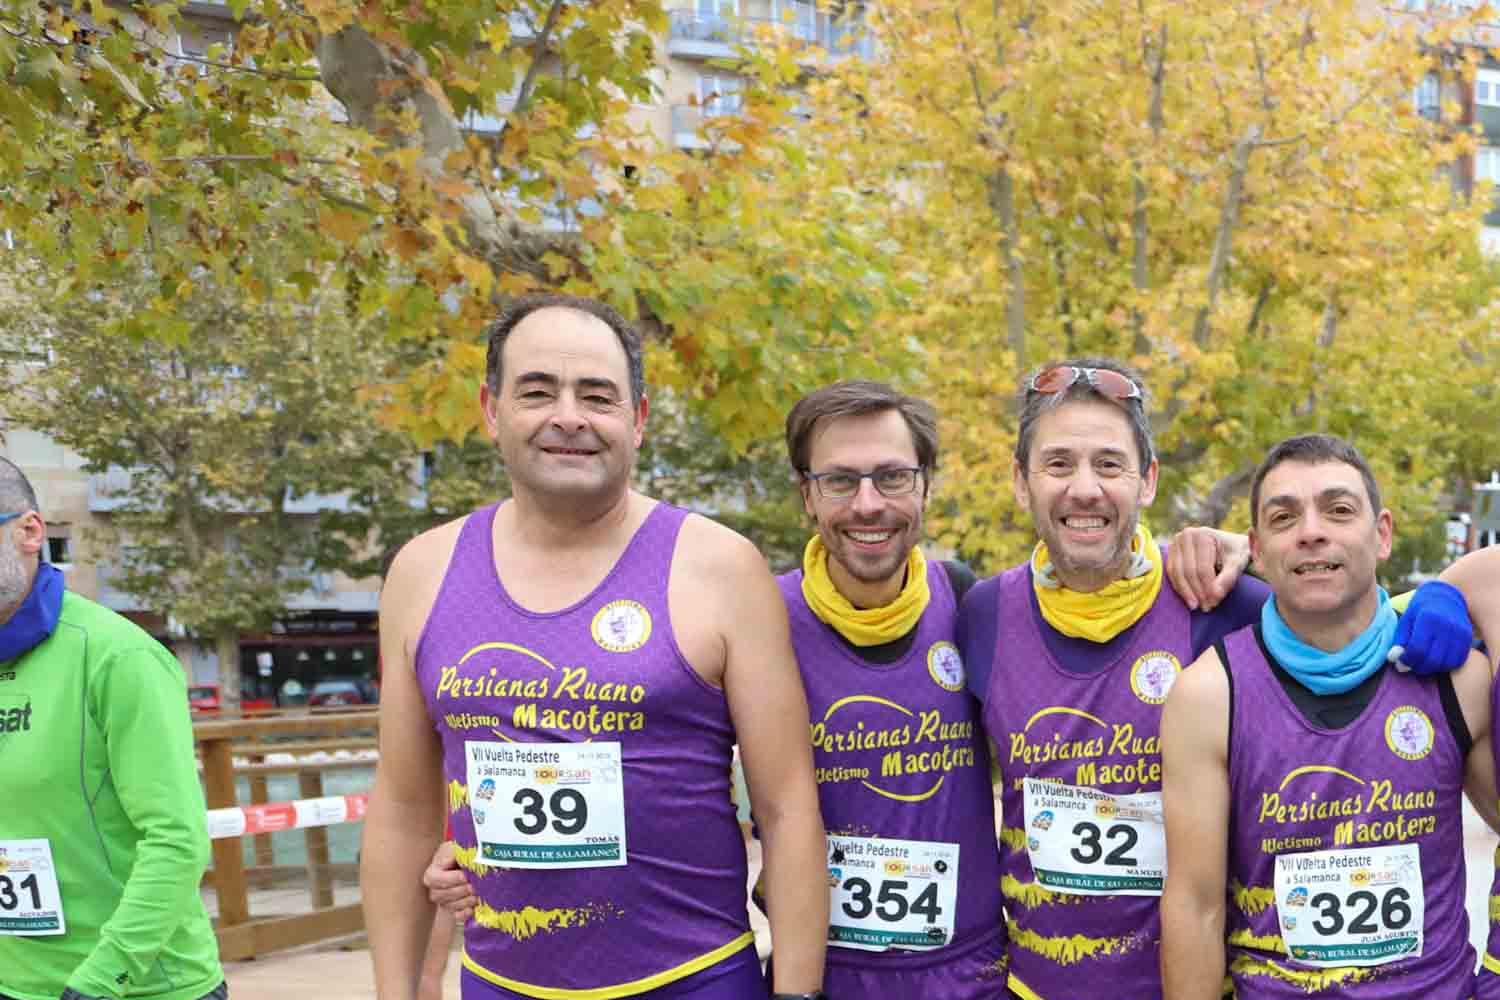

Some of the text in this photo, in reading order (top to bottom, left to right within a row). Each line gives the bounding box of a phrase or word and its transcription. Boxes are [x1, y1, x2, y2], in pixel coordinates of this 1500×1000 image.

[436, 666, 646, 704] Persianas Ruano
[512, 703, 645, 734] Macotera
[809, 722, 910, 753] Persianas
[1009, 732, 1104, 764] Persianas
[485, 748, 513, 762] Vuelta
[516, 750, 560, 763] Pedestre
[881, 747, 974, 777] Macotera
[484, 765, 526, 777] Salamanca
[1076, 758, 1162, 785] Macote
[1041, 799, 1087, 811] Salamanca
[1043, 785, 1073, 798] Vuelta
[1259, 779, 1435, 823] Persianas Ruano
[513, 788, 588, 836] 39
[586, 836, 620, 844] TOMAS
[1070, 821, 1138, 867] 32
[1334, 815, 1436, 846] Macotera
[555, 847, 620, 859] SALAMANCA
[866, 843, 910, 858] Pedestre
[1330, 856, 1372, 868] Pedestre
[1046, 877, 1065, 885] CAJA
[1066, 877, 1091, 887] RURAL
[1294, 873, 1341, 884] Salamanca
[842, 877, 943, 924] 354
[1310, 887, 1412, 936] 326
